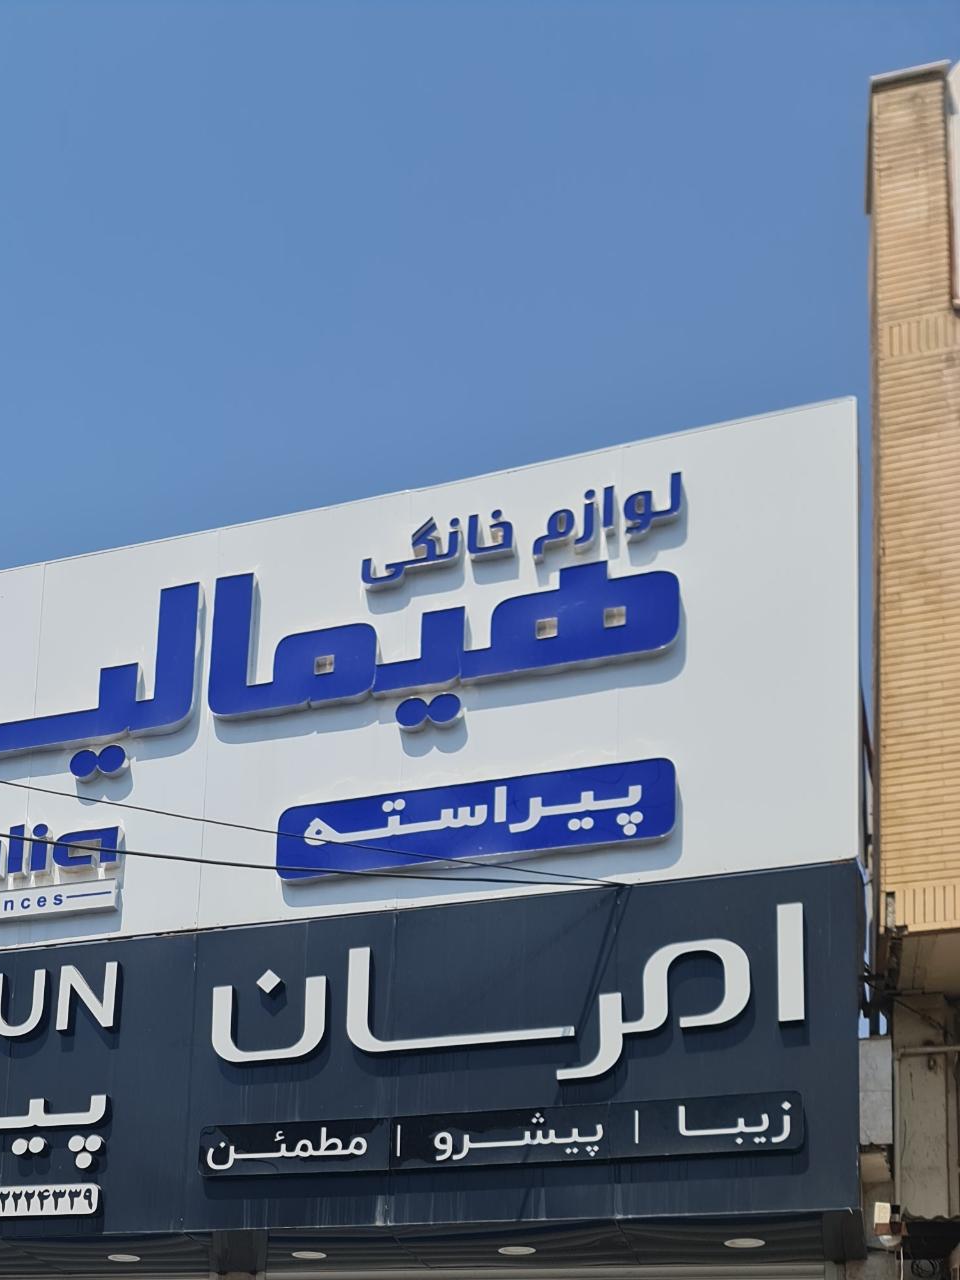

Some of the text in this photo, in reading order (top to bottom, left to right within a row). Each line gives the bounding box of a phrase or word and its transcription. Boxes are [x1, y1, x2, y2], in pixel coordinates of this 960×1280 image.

[360, 471, 683, 586] لوازم خانگی
[303, 784, 644, 846] پیراسته
[205, 1100, 793, 1170] زیبا پیشرو مطمئن
